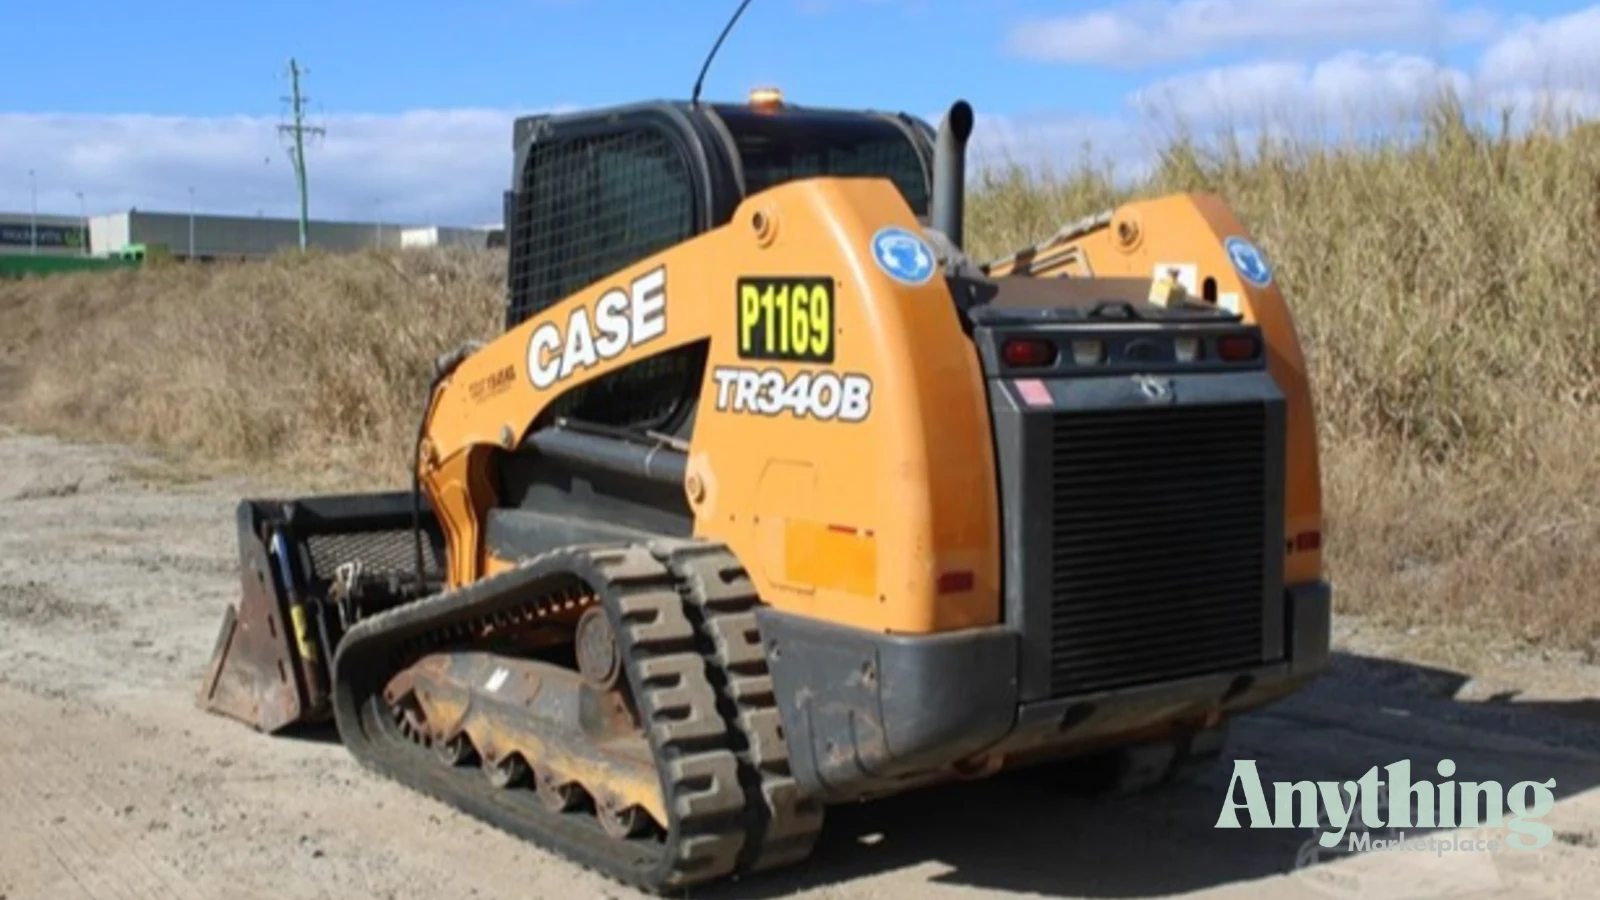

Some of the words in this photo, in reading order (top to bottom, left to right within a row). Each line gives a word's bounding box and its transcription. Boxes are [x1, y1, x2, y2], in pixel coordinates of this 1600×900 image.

[527, 264, 667, 389] CASE
[741, 284, 829, 355] P1169
[714, 367, 872, 421] TR340B
